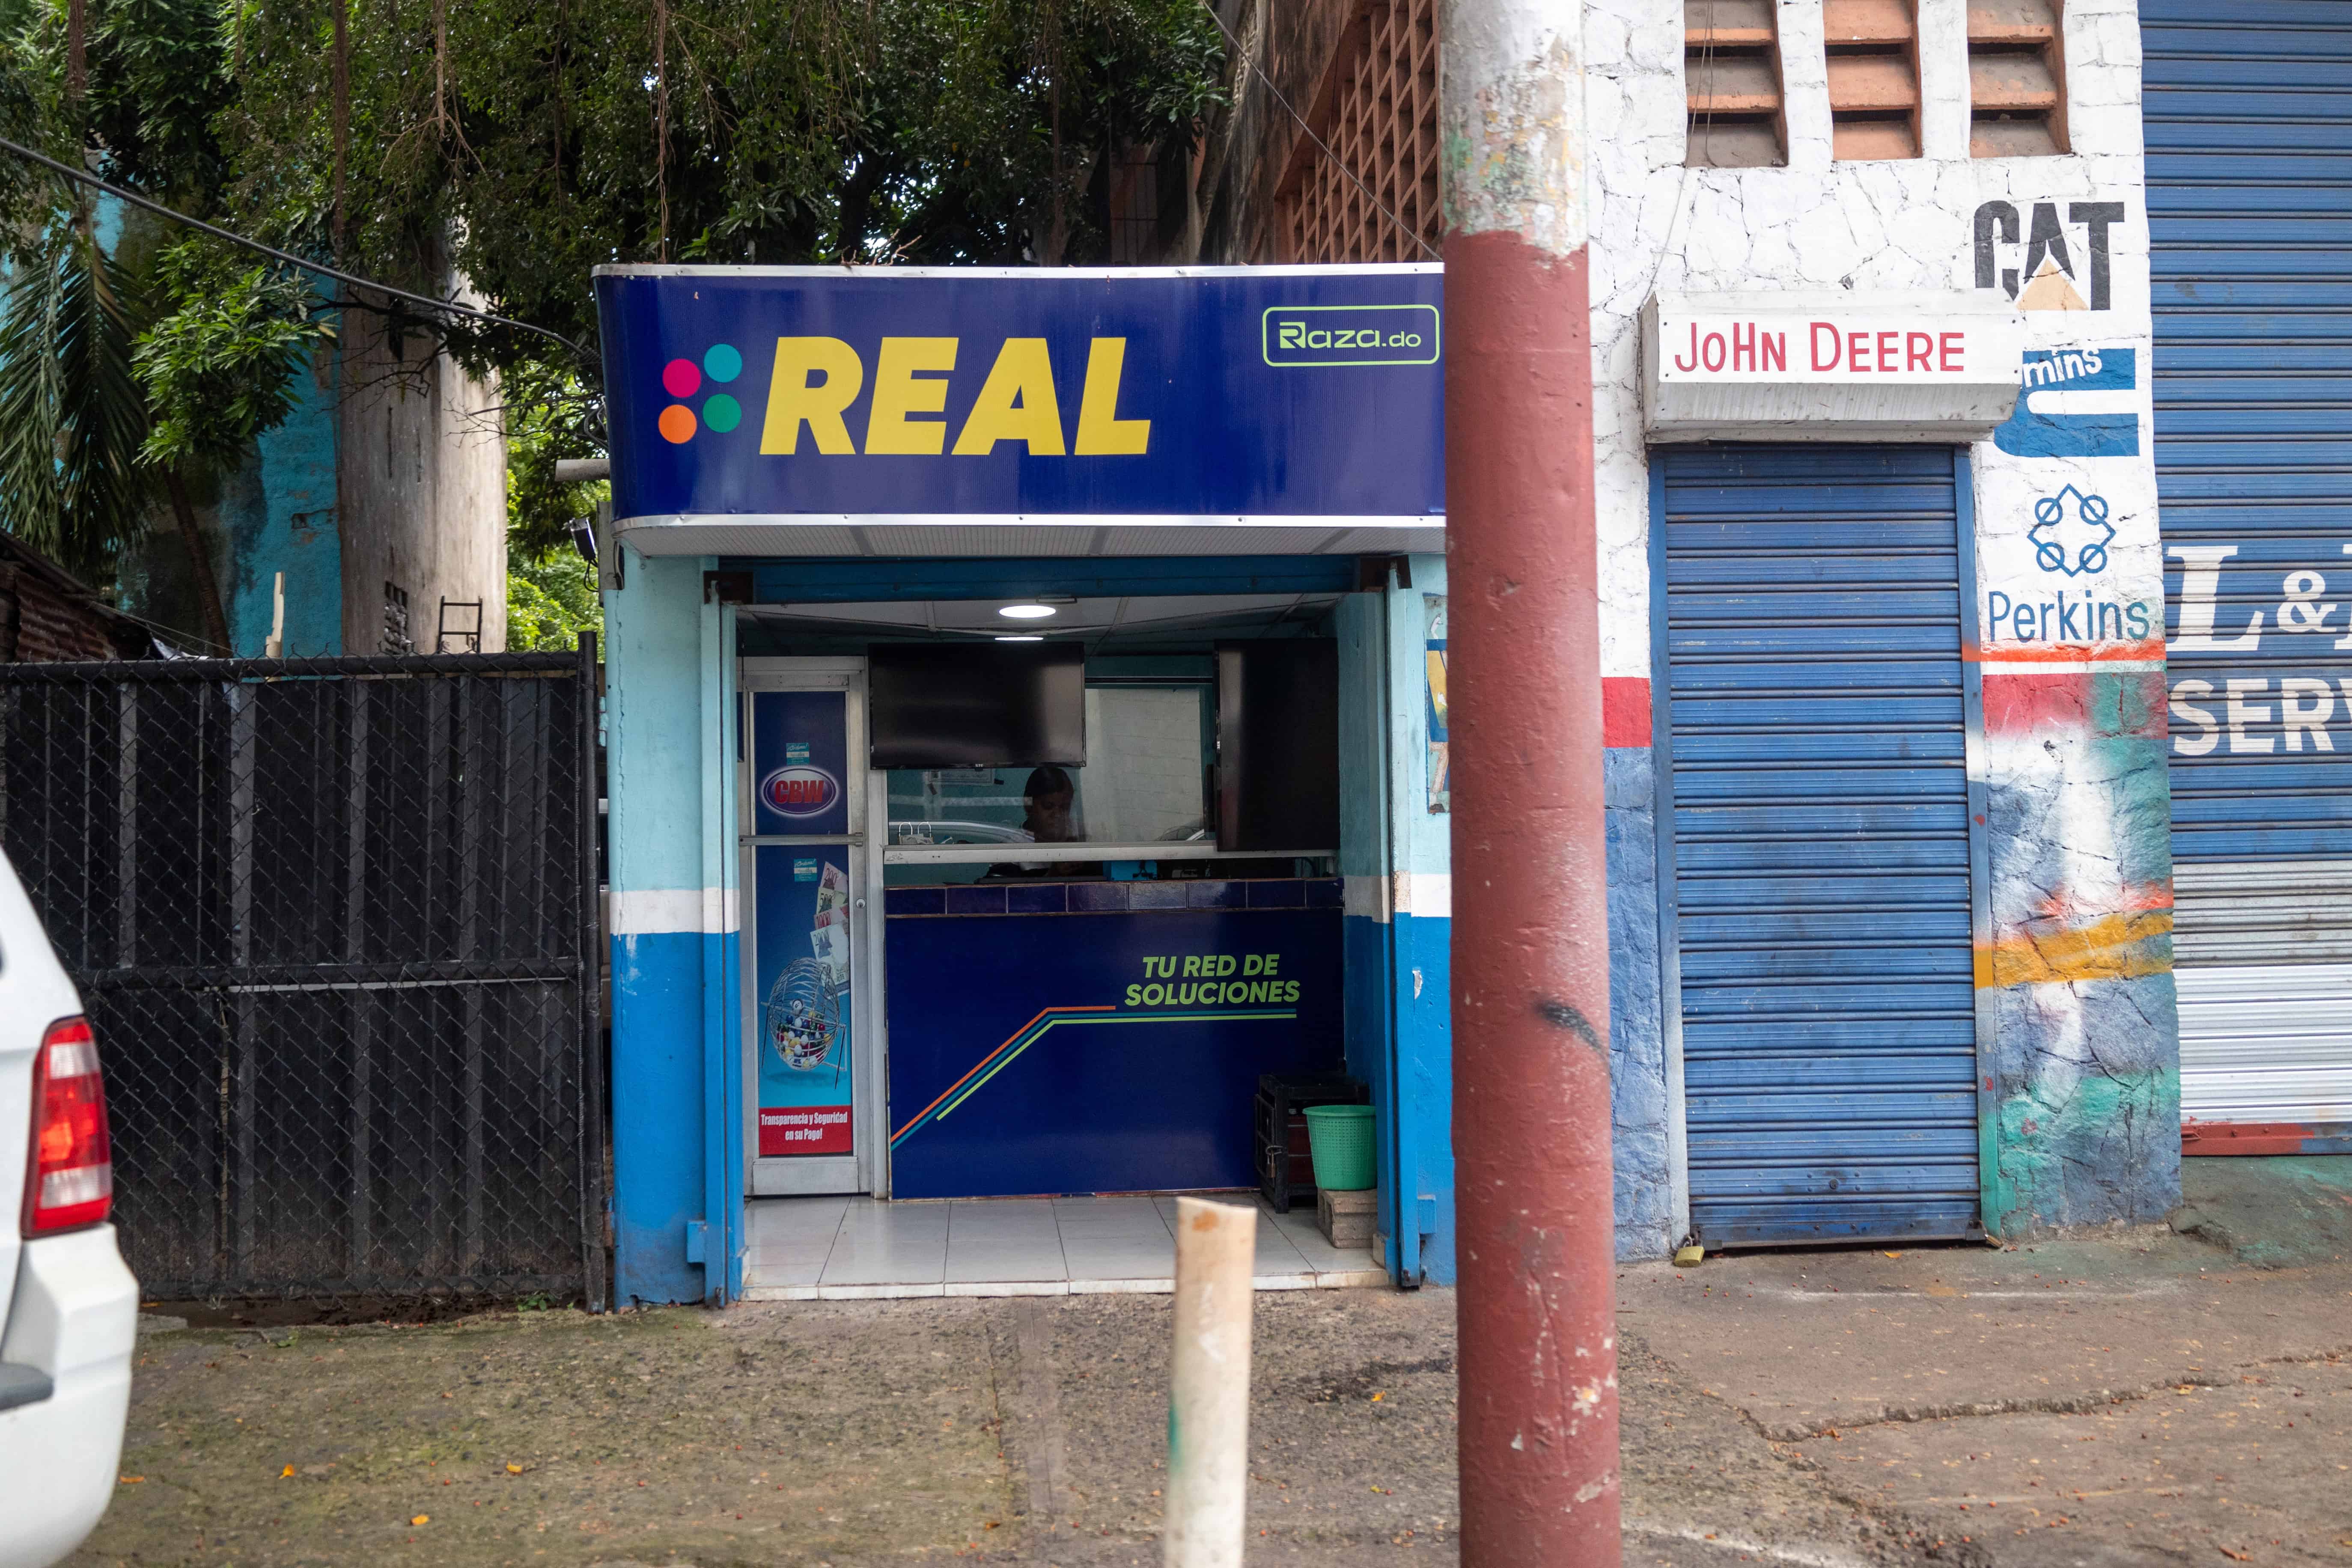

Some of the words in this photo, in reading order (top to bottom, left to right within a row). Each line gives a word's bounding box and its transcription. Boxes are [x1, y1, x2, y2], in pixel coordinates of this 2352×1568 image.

[1974, 200, 2125, 310] CAT
[1280, 322, 1421, 348] Raza.do
[1810, 322, 1964, 372] DEERE
[760, 337, 1151, 455] REAL
[1989, 590, 2150, 642] Perkins
[775, 780, 824, 803] CBW
[1142, 956, 1176, 978] TU
[1183, 955, 1236, 978] RED
[1243, 954, 1280, 976] DE
[1125, 980, 1300, 1006] SOLUCIONES
[761, 1113, 808, 1126] Transparencia
[809, 1114, 814, 1125] y
[814, 1112, 848, 1125] Seguridad
[785, 1131, 794, 1140] en
[795, 1130, 803, 1140] su
[804, 1128, 823, 1141] Pago!
